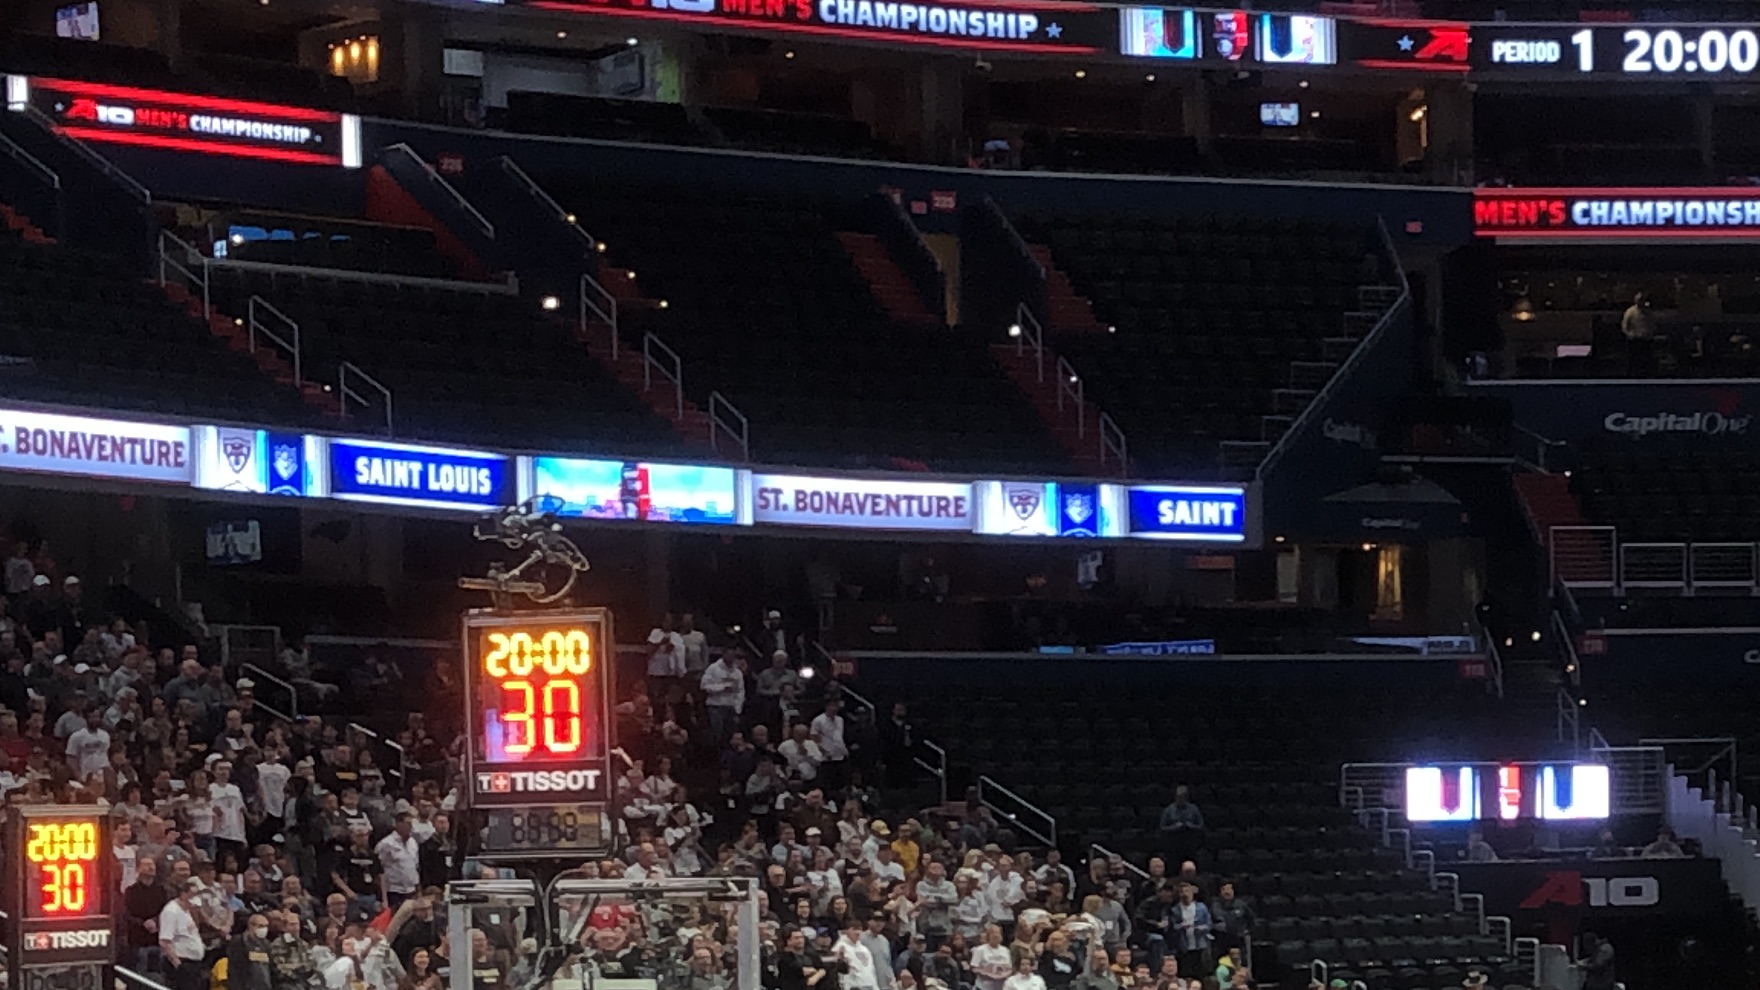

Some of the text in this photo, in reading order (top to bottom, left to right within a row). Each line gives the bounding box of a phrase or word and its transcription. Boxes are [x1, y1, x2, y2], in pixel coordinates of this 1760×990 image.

[819, 0, 1038, 39] CHAMPIONSHIP
[1492, 29, 1760, 73] PERIOD 1 20:00
[136, 108, 187, 129] MEN'S
[189, 114, 312, 143] CHAMPIONSHIP
[1474, 200, 1567, 225] MEN'S
[15, 425, 186, 468] BONAVENTURE
[354, 455, 493, 496] SAINT LOUIS
[757, 487, 966, 518] ST. BONAVENTURE
[1158, 499, 1238, 527] SAINT
[485, 630, 591, 677] 20:00
[500, 679, 581, 754] 30
[510, 769, 601, 791] TISSOT
[27, 822, 97, 862] 20:00
[41, 863, 85, 912] 30
[1519, 870, 1660, 908] A10
[50, 929, 111, 949] TISSOT
